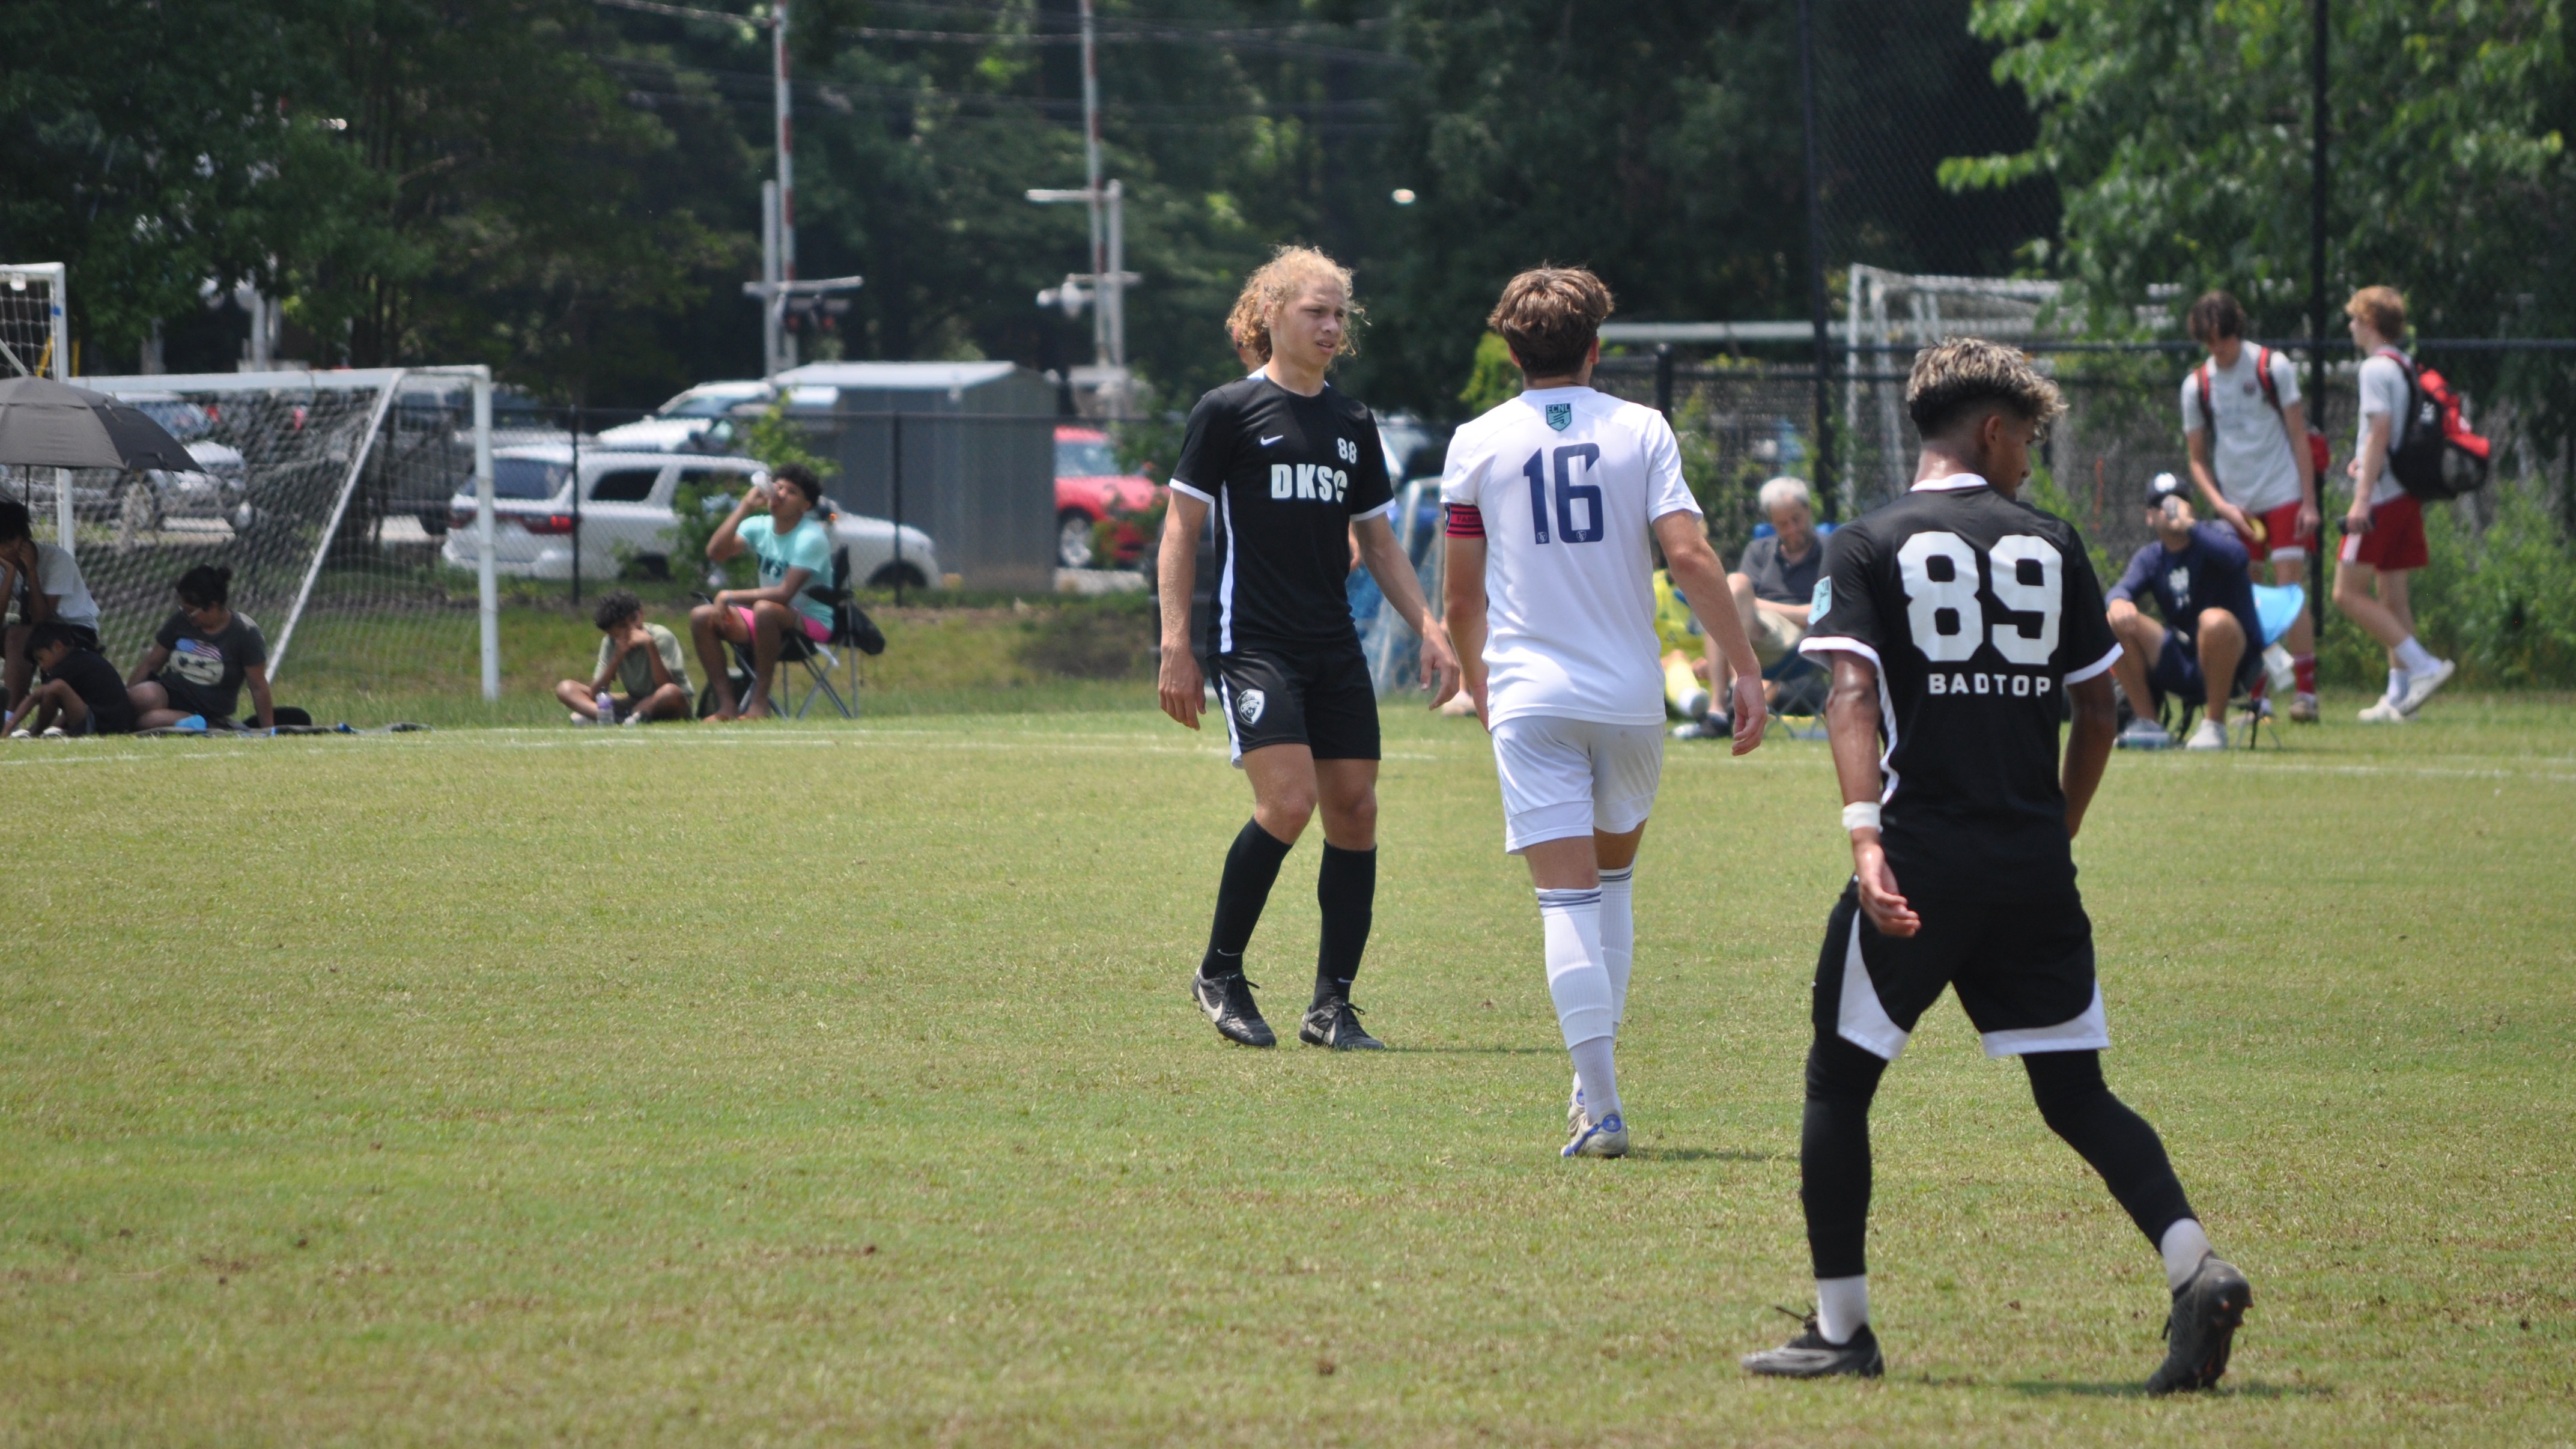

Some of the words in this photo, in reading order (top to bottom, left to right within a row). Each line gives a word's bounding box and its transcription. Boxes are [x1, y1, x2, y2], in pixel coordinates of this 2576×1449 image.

[1547, 404, 1570, 413] ECNL
[1337, 437, 1356, 464] 88
[1271, 463, 1347, 503] DKSC
[1523, 442, 1604, 545] 16
[1897, 531, 2062, 665] 89
[1928, 673, 2051, 697] BADTOP
